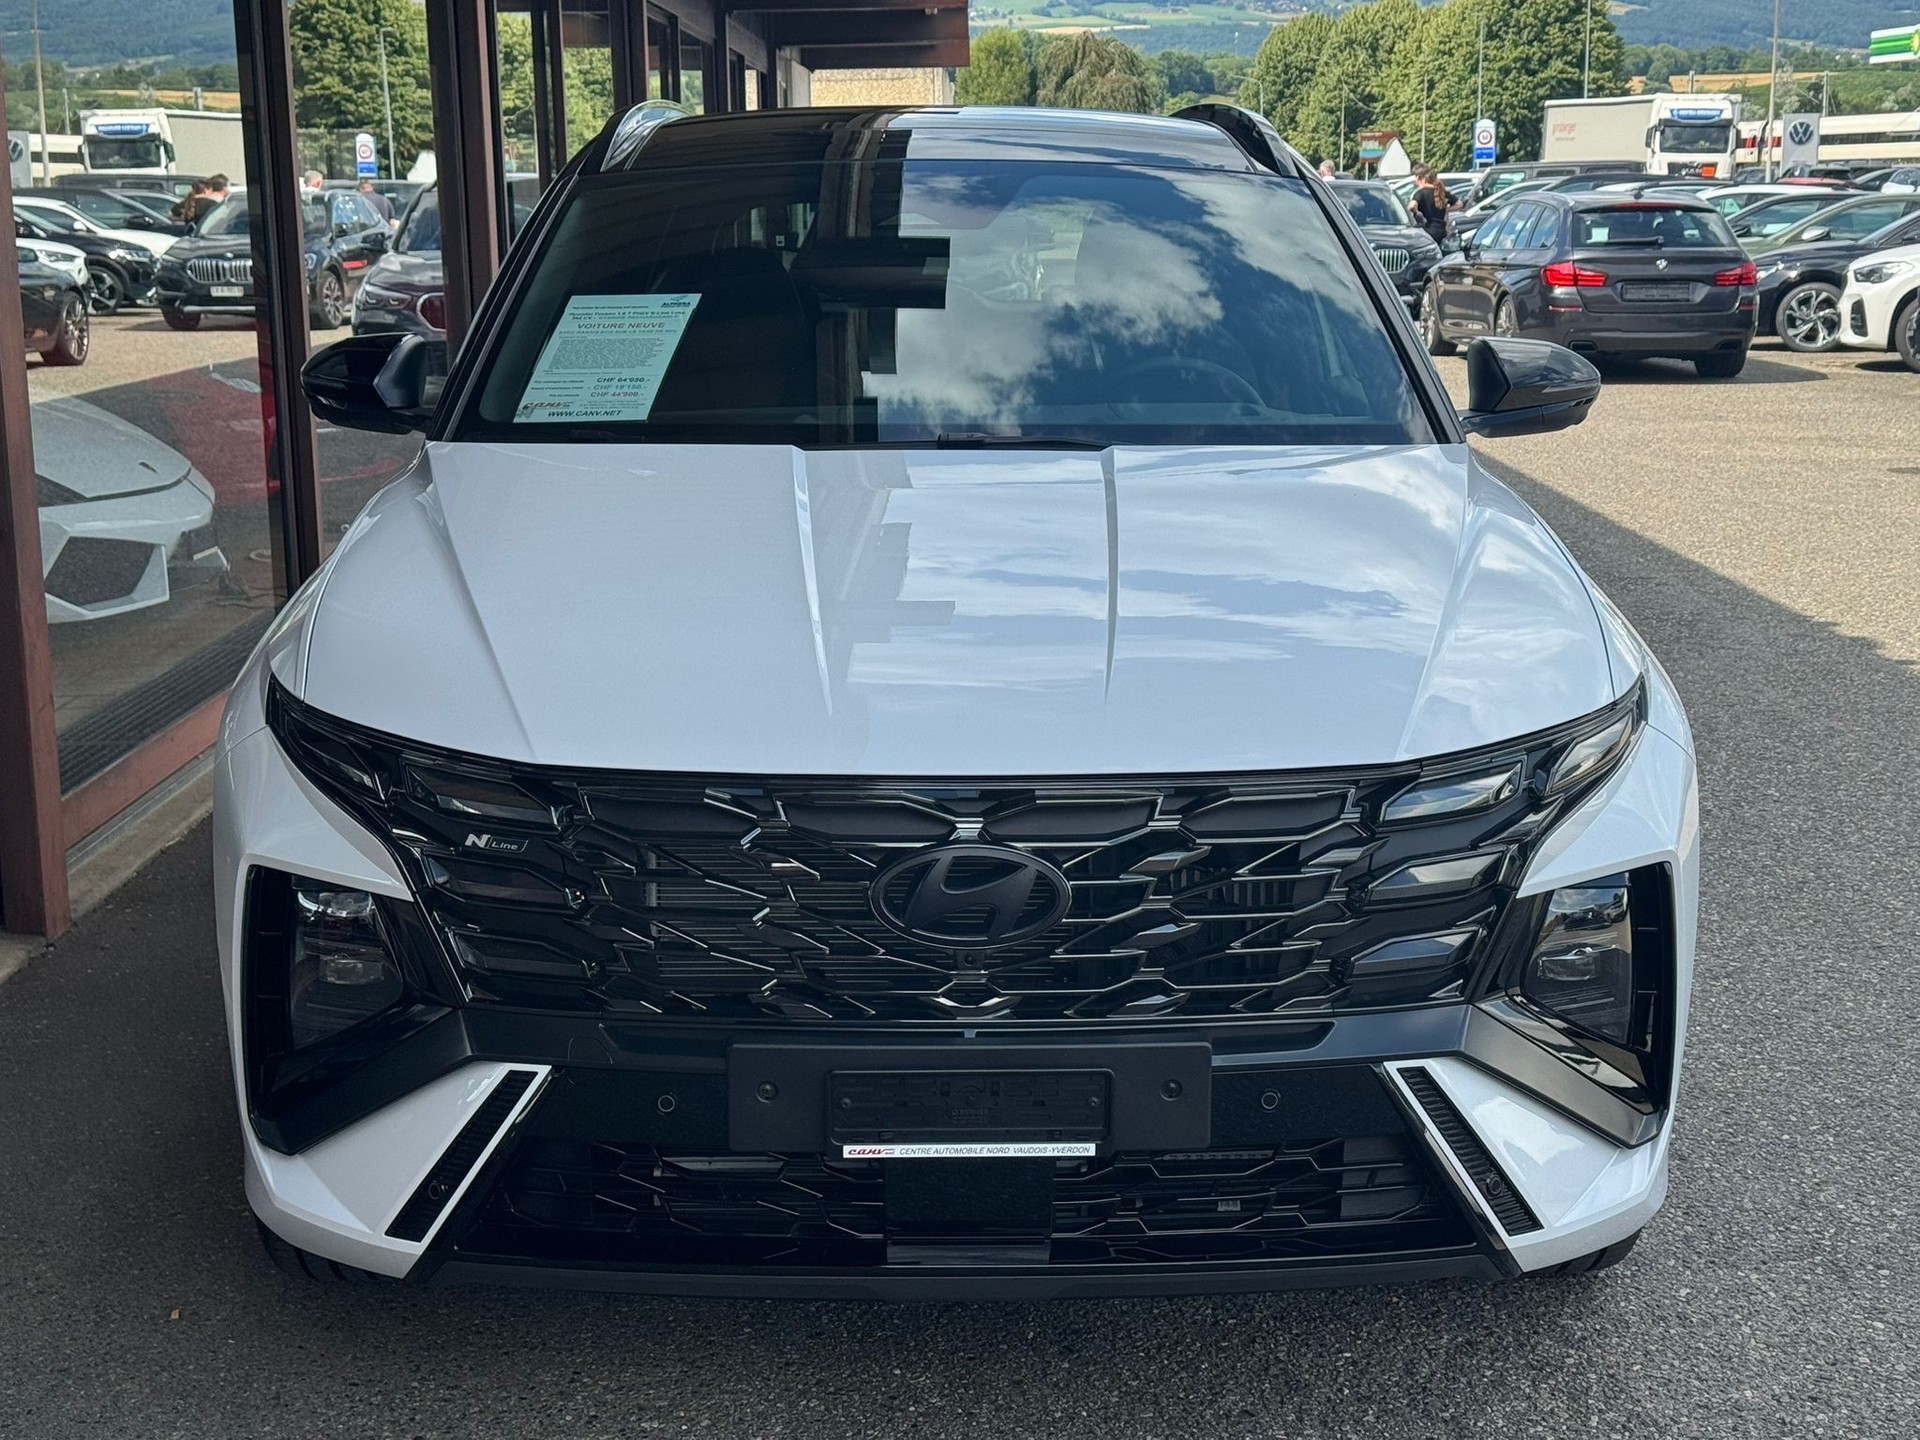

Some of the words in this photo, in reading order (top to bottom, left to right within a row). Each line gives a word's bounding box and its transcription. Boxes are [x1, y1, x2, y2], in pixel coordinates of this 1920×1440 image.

[465, 834, 491, 848] N
[491, 841, 518, 850] Line
[900, 1147, 931, 1155] CENTRE
